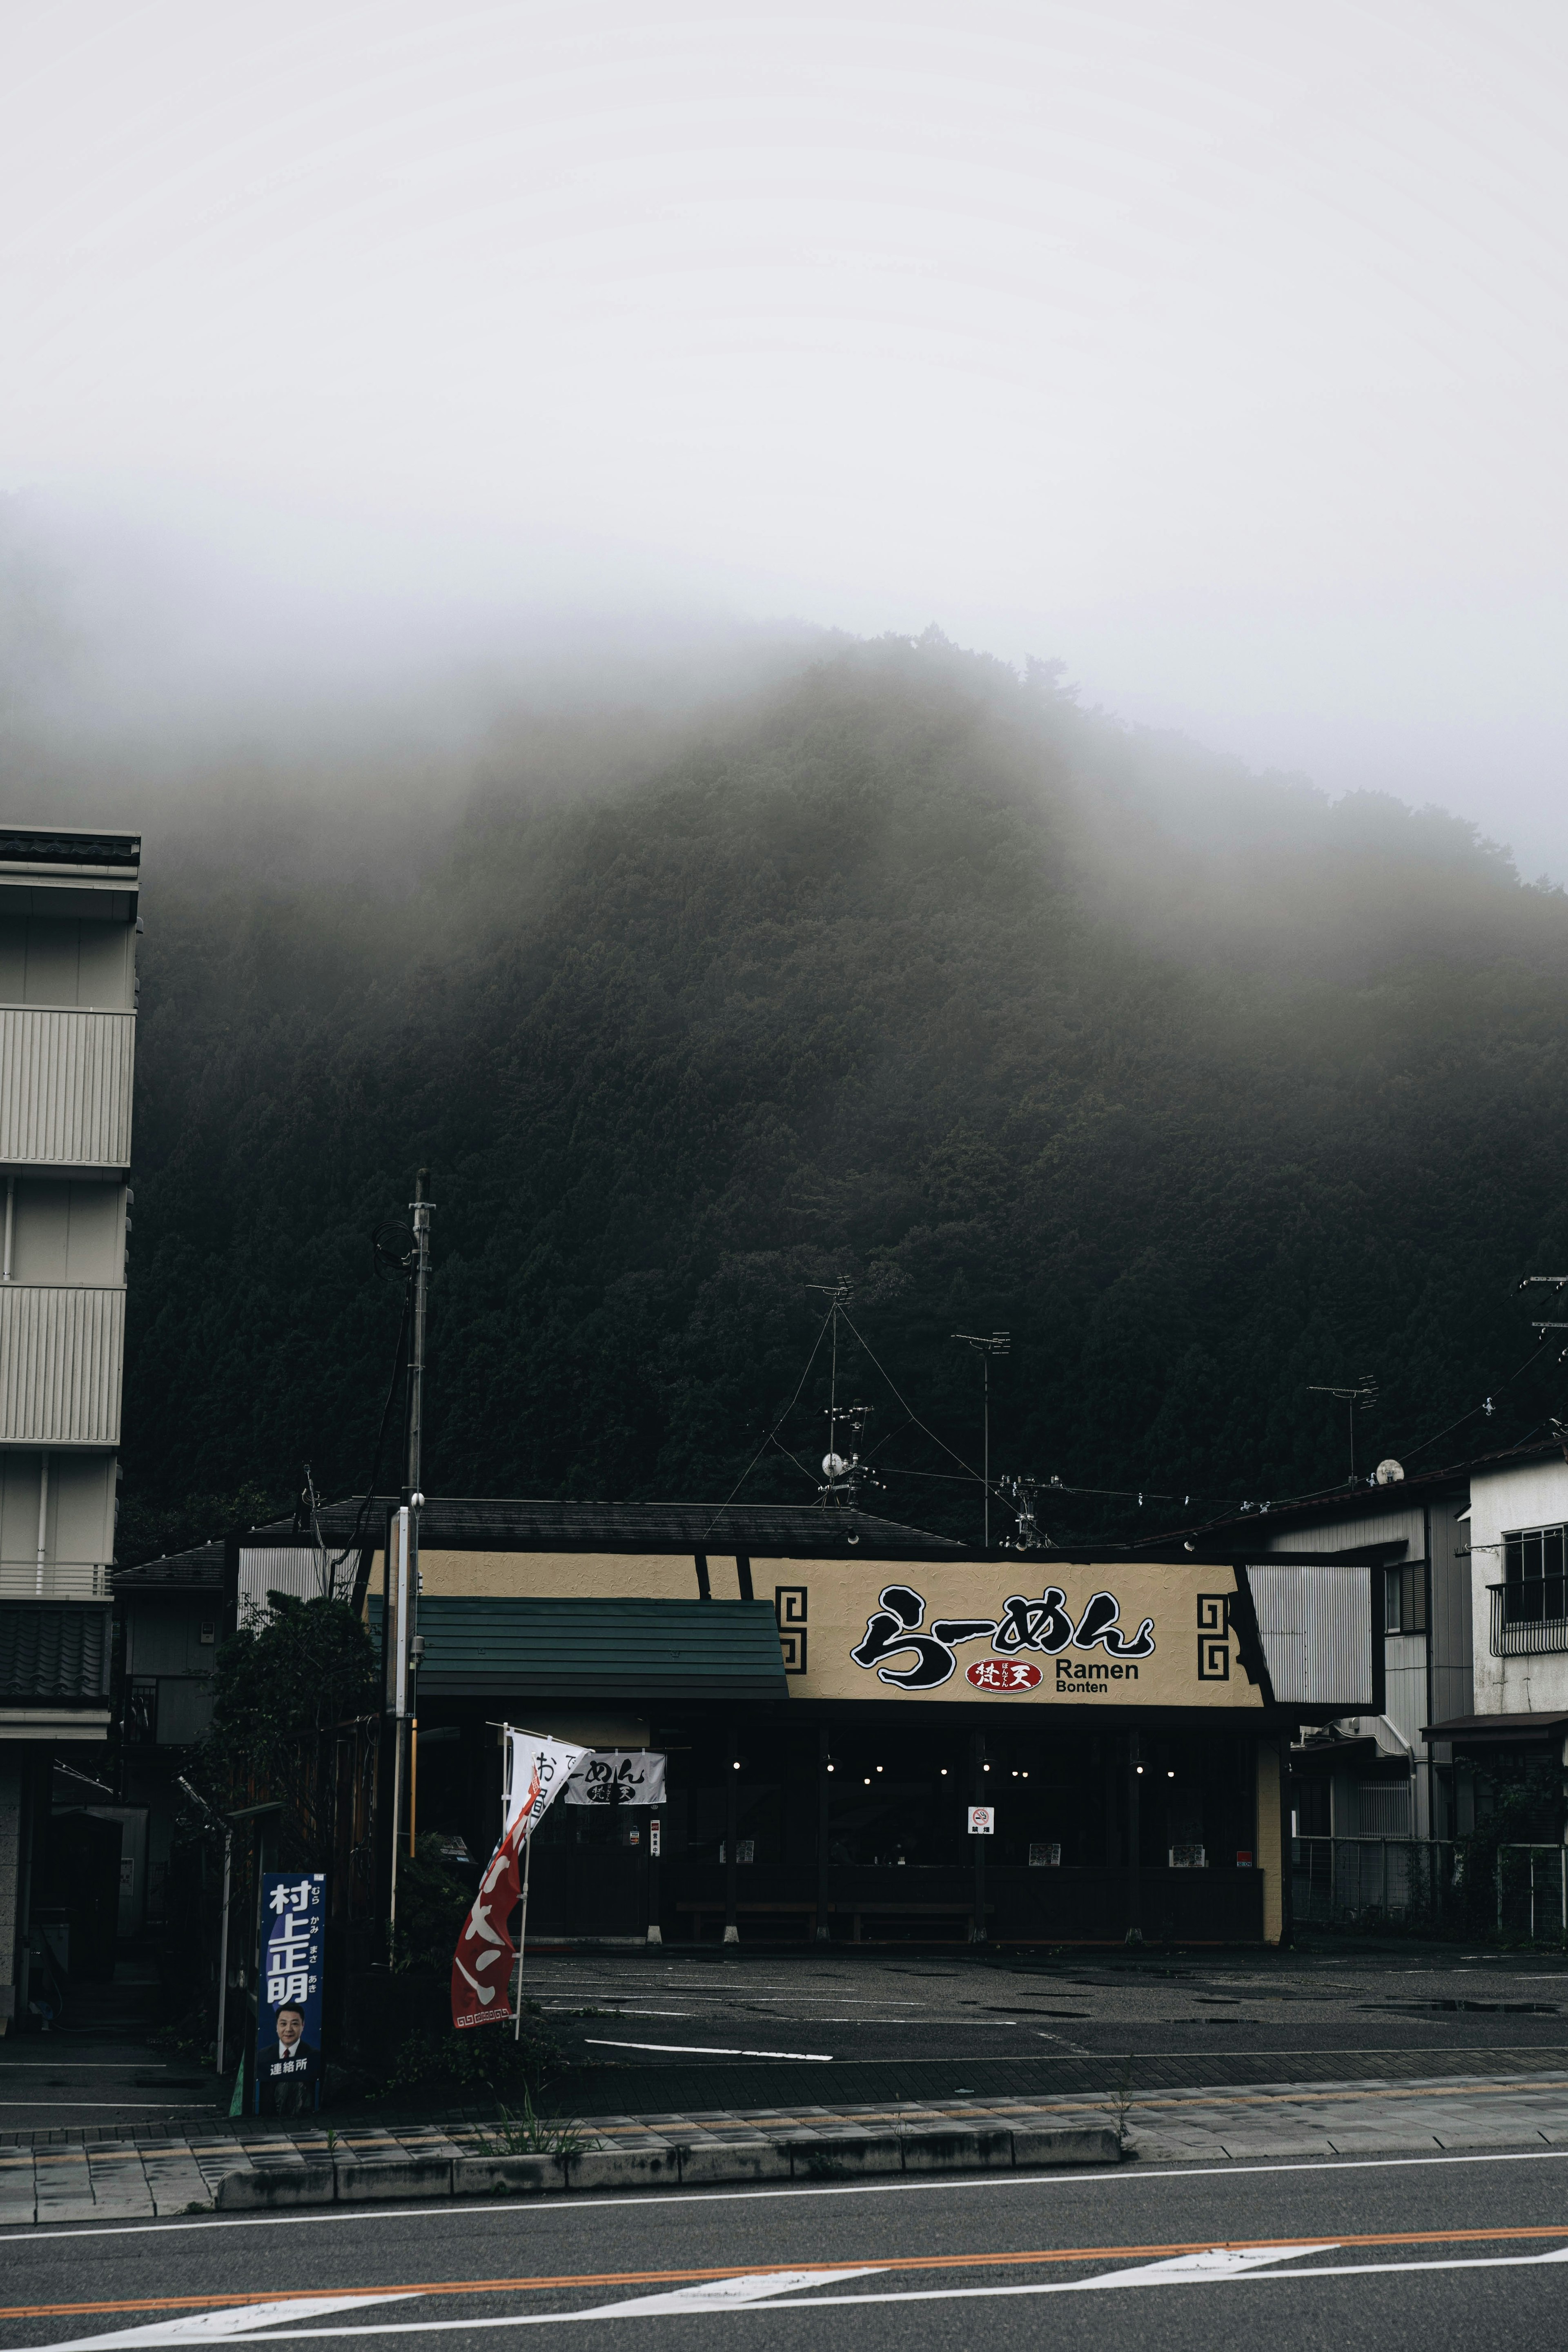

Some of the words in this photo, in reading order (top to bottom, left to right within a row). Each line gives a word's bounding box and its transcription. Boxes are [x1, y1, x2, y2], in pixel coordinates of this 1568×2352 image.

[851, 1584, 1155, 1690] らーめん
[975, 1663, 1031, 1687] 梵天
[1056, 1659, 1138, 1679] Ramen
[1056, 1680, 1108, 1693] Bonten
[592, 1786, 631, 1800] 梵天
[311, 1886, 320, 1904] むら
[310, 1916, 319, 1934] かみ
[267, 1880, 312, 2005] 村上正明
[309, 1945, 318, 1964] まさ
[308, 1975, 317, 1993] あき
[270, 2058, 307, 2076] 連絡所
